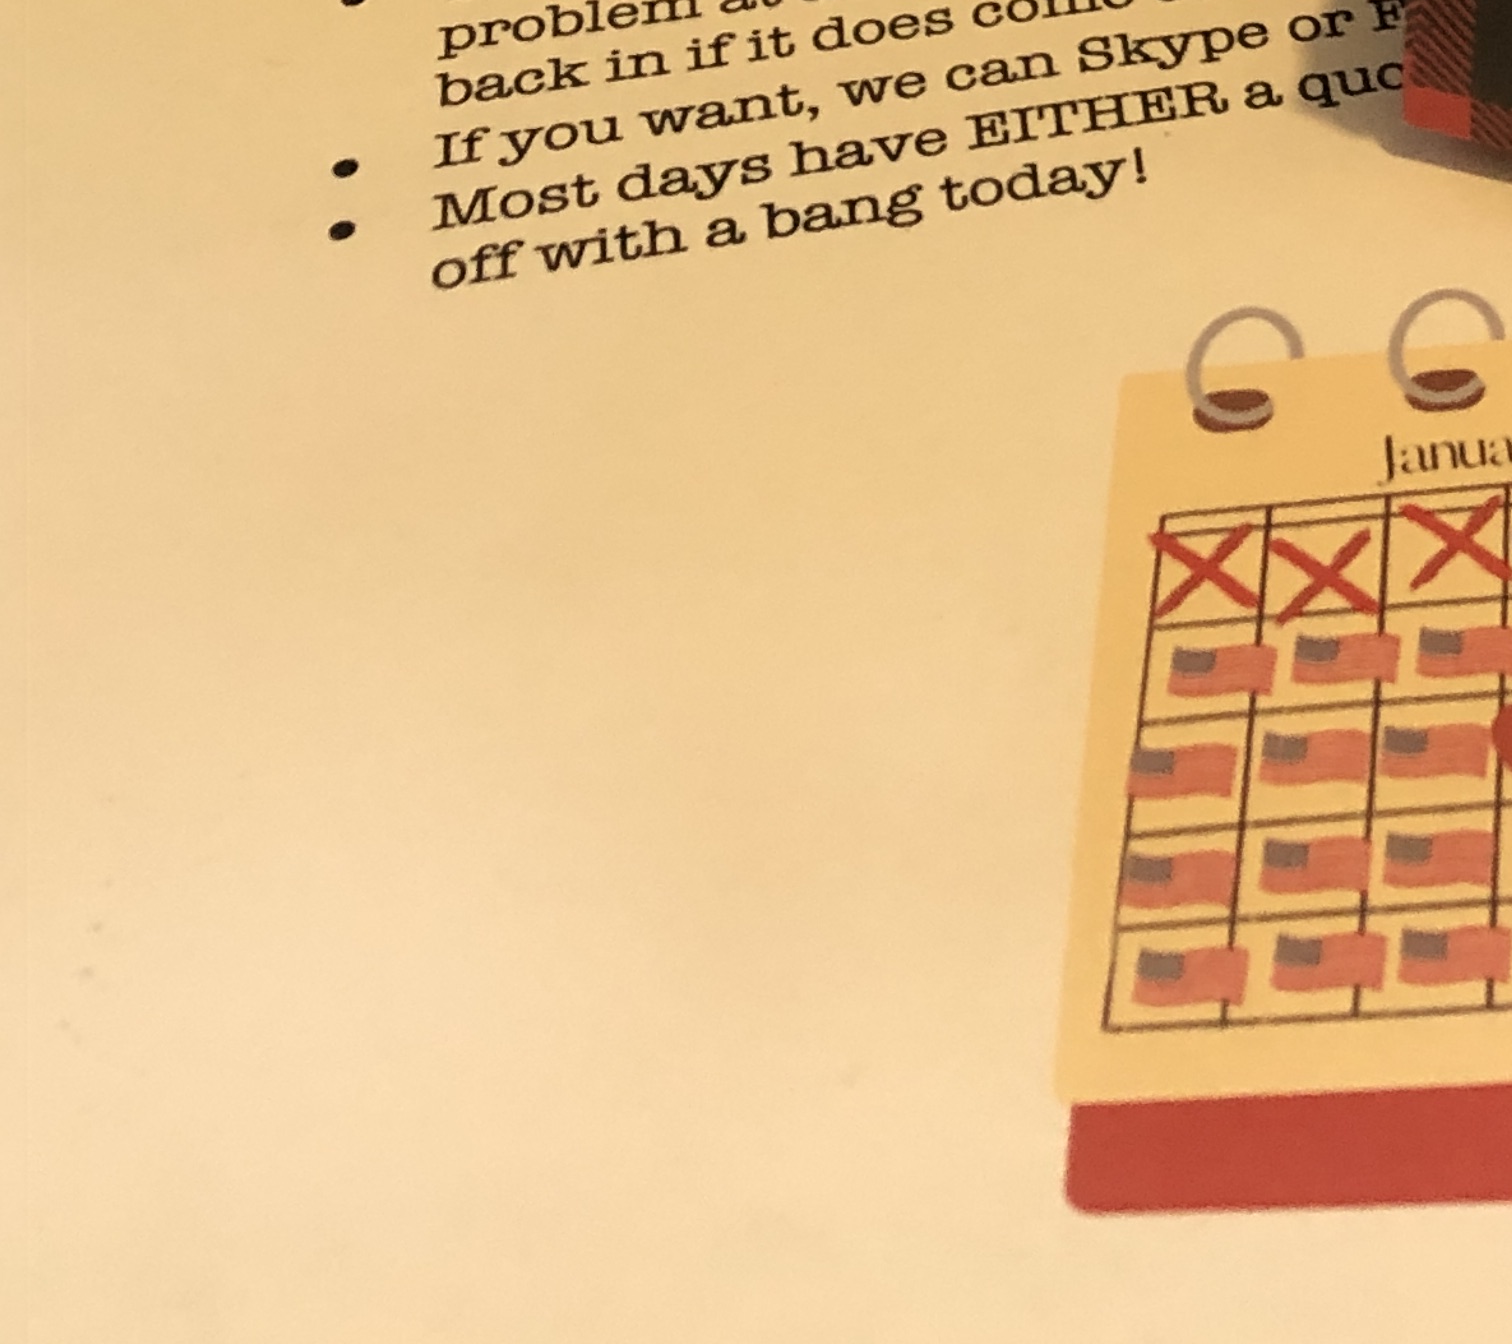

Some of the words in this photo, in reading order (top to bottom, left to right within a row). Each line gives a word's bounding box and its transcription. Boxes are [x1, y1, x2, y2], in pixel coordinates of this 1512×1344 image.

[433, 126, 491, 169] If
[498, 116, 624, 167] you
[637, 84, 820, 137] want,
[836, 71, 927, 107] we
[945, 52, 1062, 91] can
[1077, 22, 1269, 73] Skype
[1288, 10, 1354, 42] or
[434, 57, 591, 108] back
[605, 49, 671, 83] in
[686, 32, 737, 72] if
[746, 26, 796, 63] it
[812, 7, 955, 52] does
[431, 174, 600, 231] Most
[617, 153, 773, 202] days
[788, 128, 948, 177] have
[964, 81, 1229, 151] EITHER
[1244, 80, 1284, 110] a
[431, 238, 526, 291] off
[533, 219, 689, 273] with
[705, 217, 748, 248] a
[759, 183, 924, 240] bang
[938, 147, 1147, 212] today!
